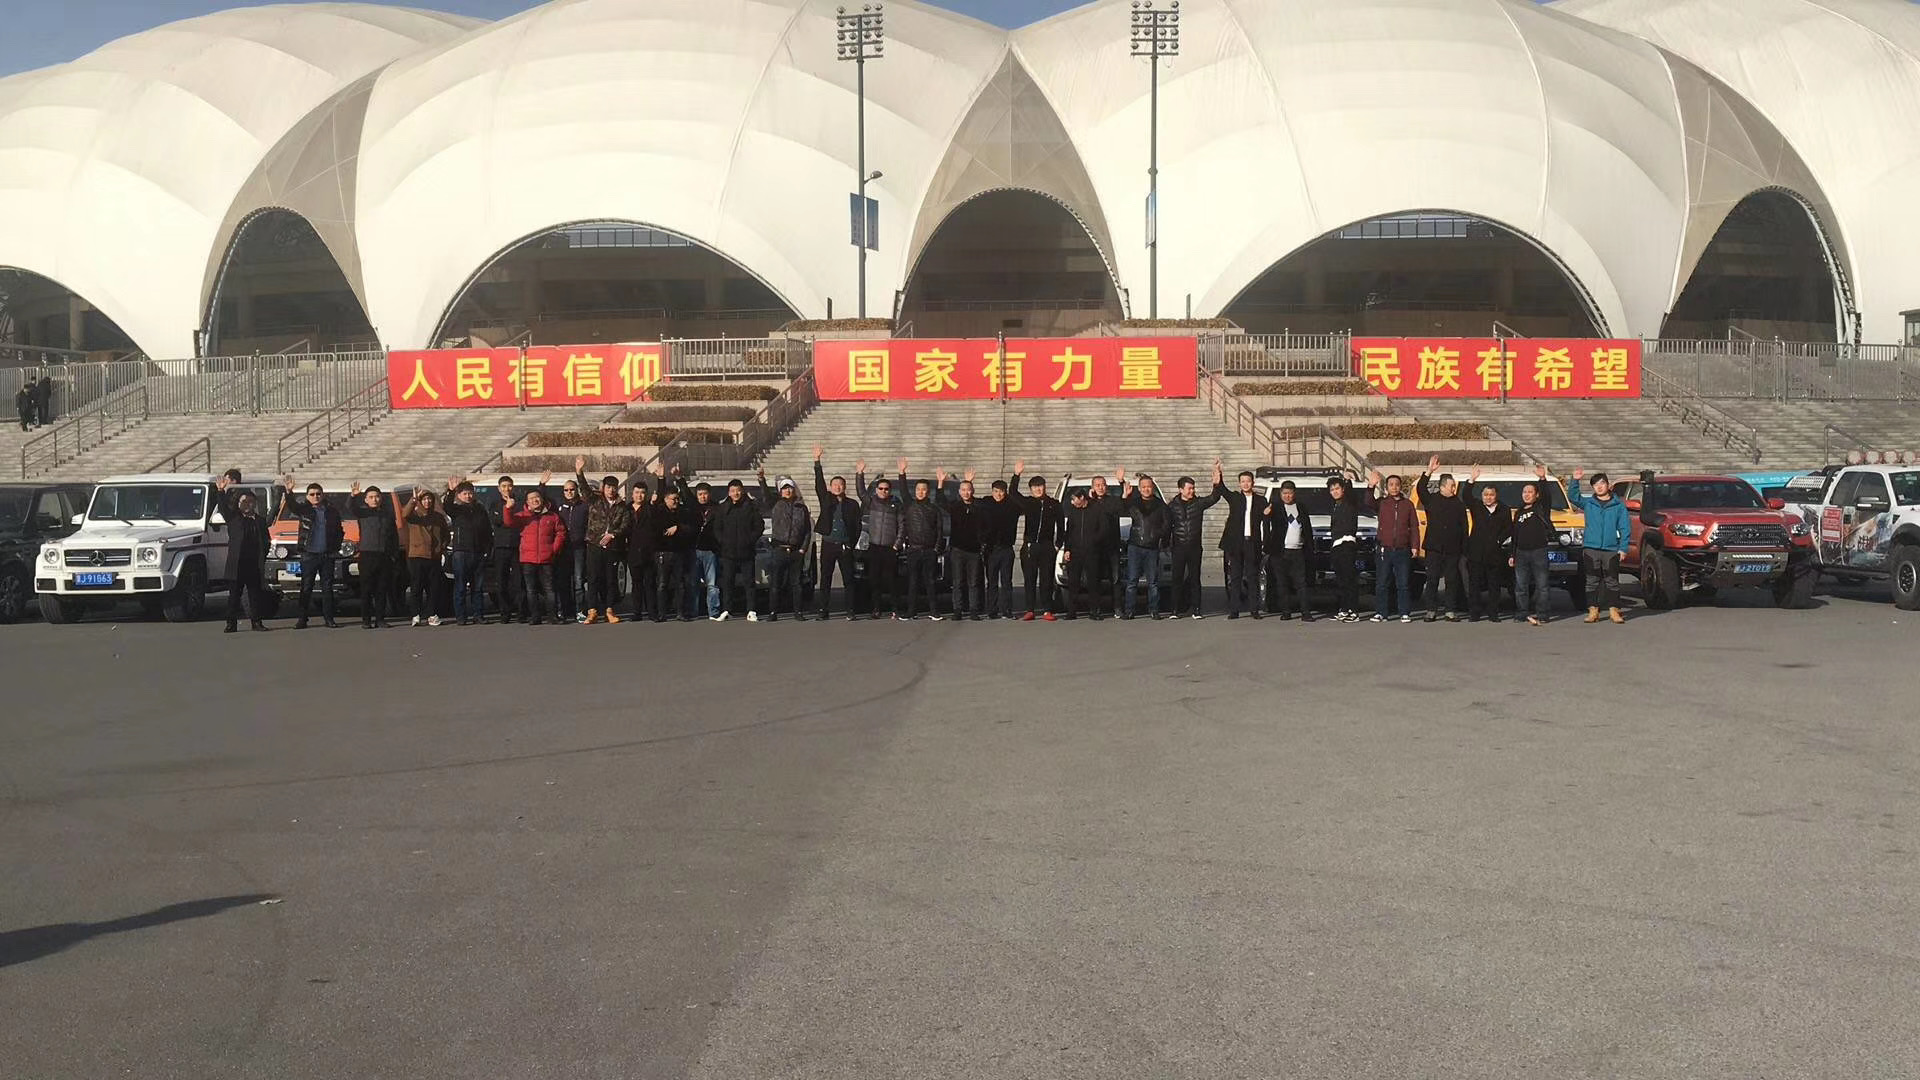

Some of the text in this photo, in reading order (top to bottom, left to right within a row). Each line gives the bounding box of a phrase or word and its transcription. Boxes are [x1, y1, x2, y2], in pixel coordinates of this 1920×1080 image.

[401, 351, 660, 401] 人民有信仰
[848, 346, 1163, 393] 国家有力量
[1360, 346, 1630, 391] 民族有希望
